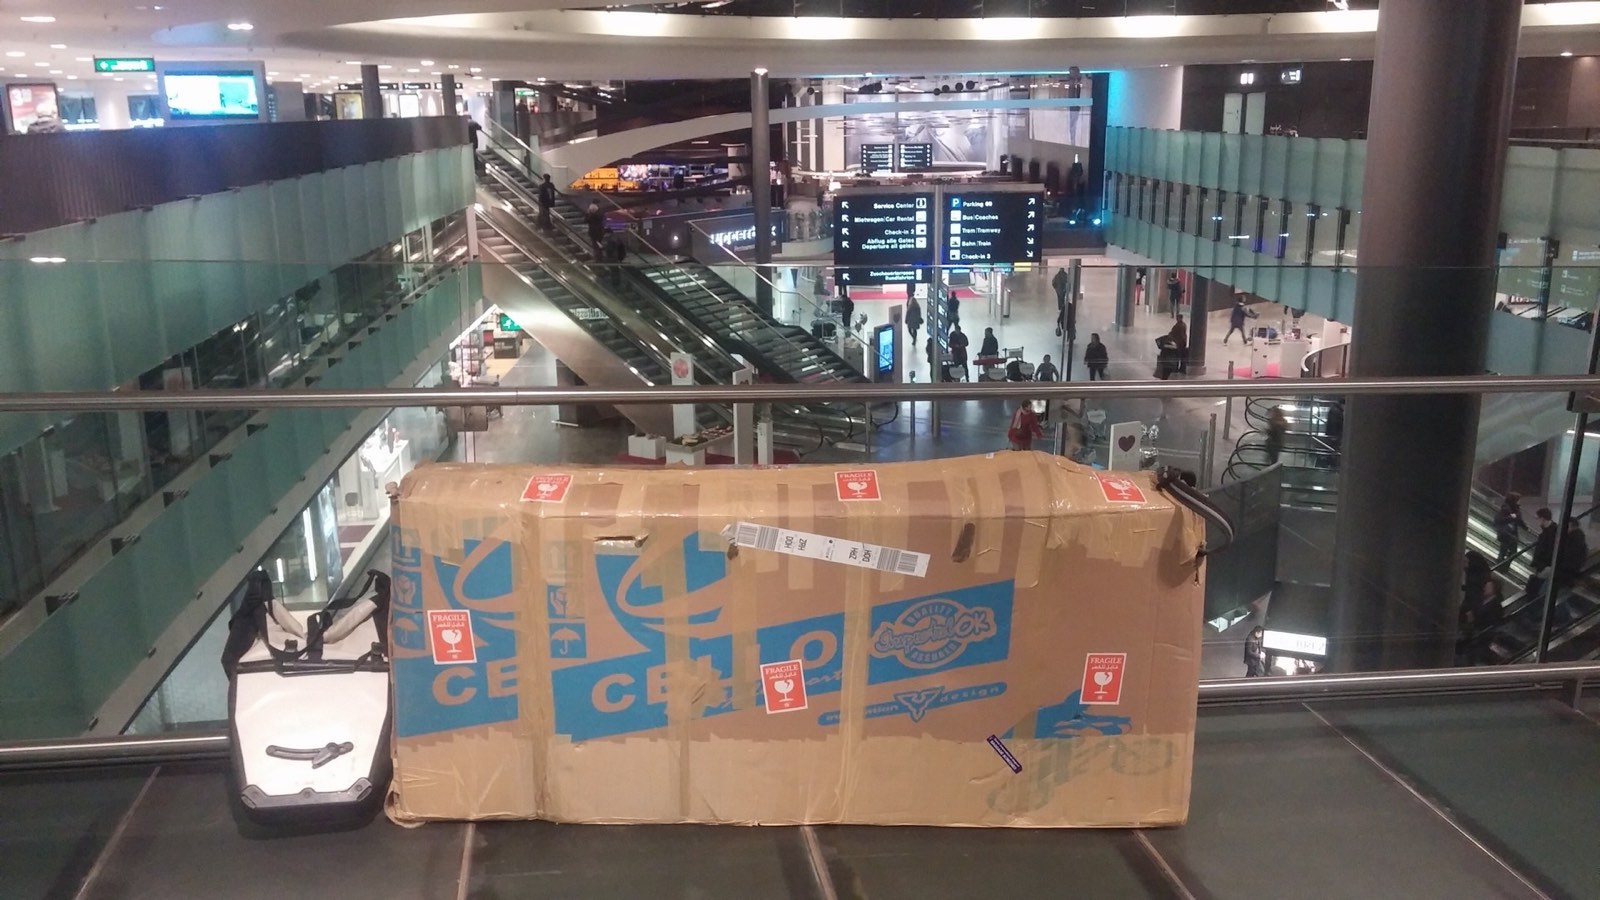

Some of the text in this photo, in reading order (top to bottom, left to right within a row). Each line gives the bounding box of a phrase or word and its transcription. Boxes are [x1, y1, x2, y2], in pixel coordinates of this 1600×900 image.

[784, 536, 794, 549] DOH
[797, 538, 808, 551] ZRH
[862, 549, 872, 563] DOH
[432, 613, 467, 621] FRAGILE
[906, 605, 953, 624] QUALITY
[911, 642, 958, 662] ASSURED
[765, 664, 799, 675] FRAGILE
[940, 686, 1000, 703] design
